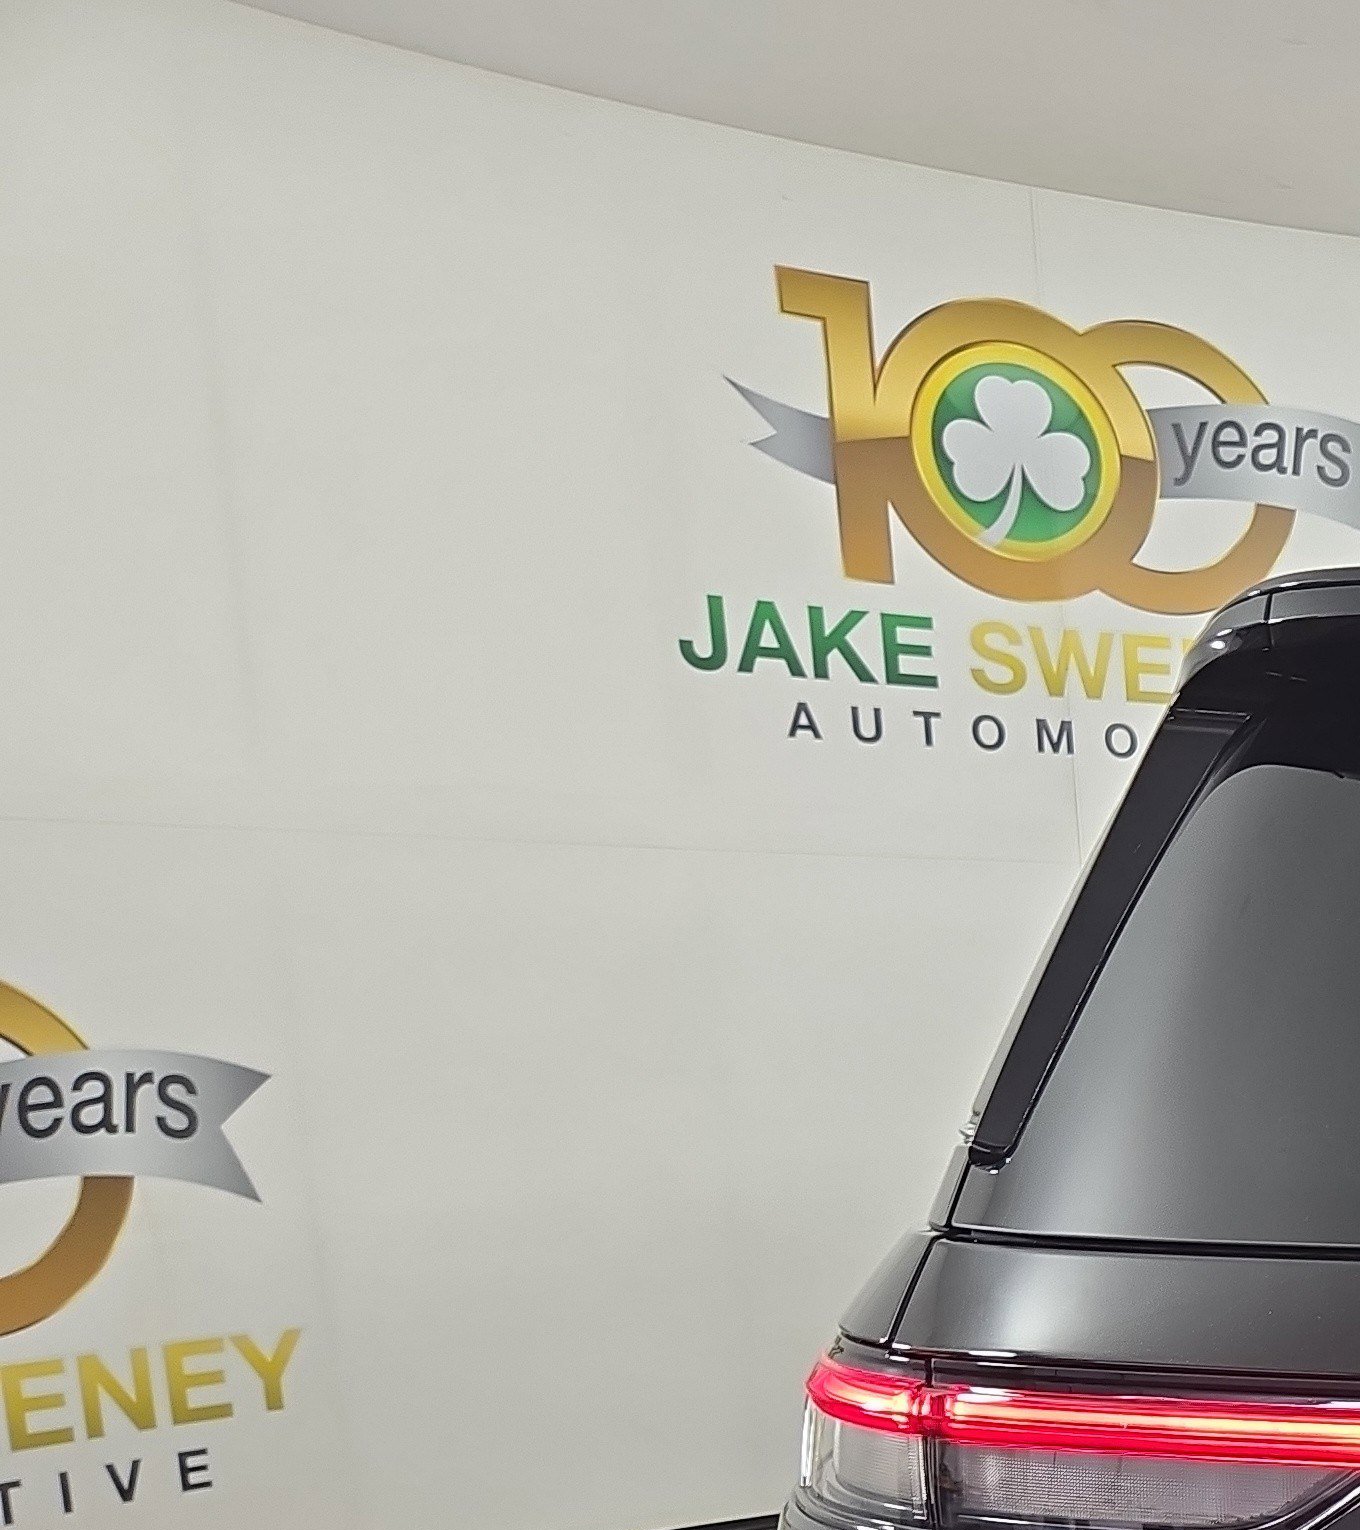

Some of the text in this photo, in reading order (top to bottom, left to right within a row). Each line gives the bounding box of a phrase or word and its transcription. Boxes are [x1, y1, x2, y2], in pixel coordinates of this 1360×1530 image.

[1171, 413, 1353, 488] years
[677, 594, 1196, 704] JAKE SWE
[0, 1070, 199, 1141] ears
